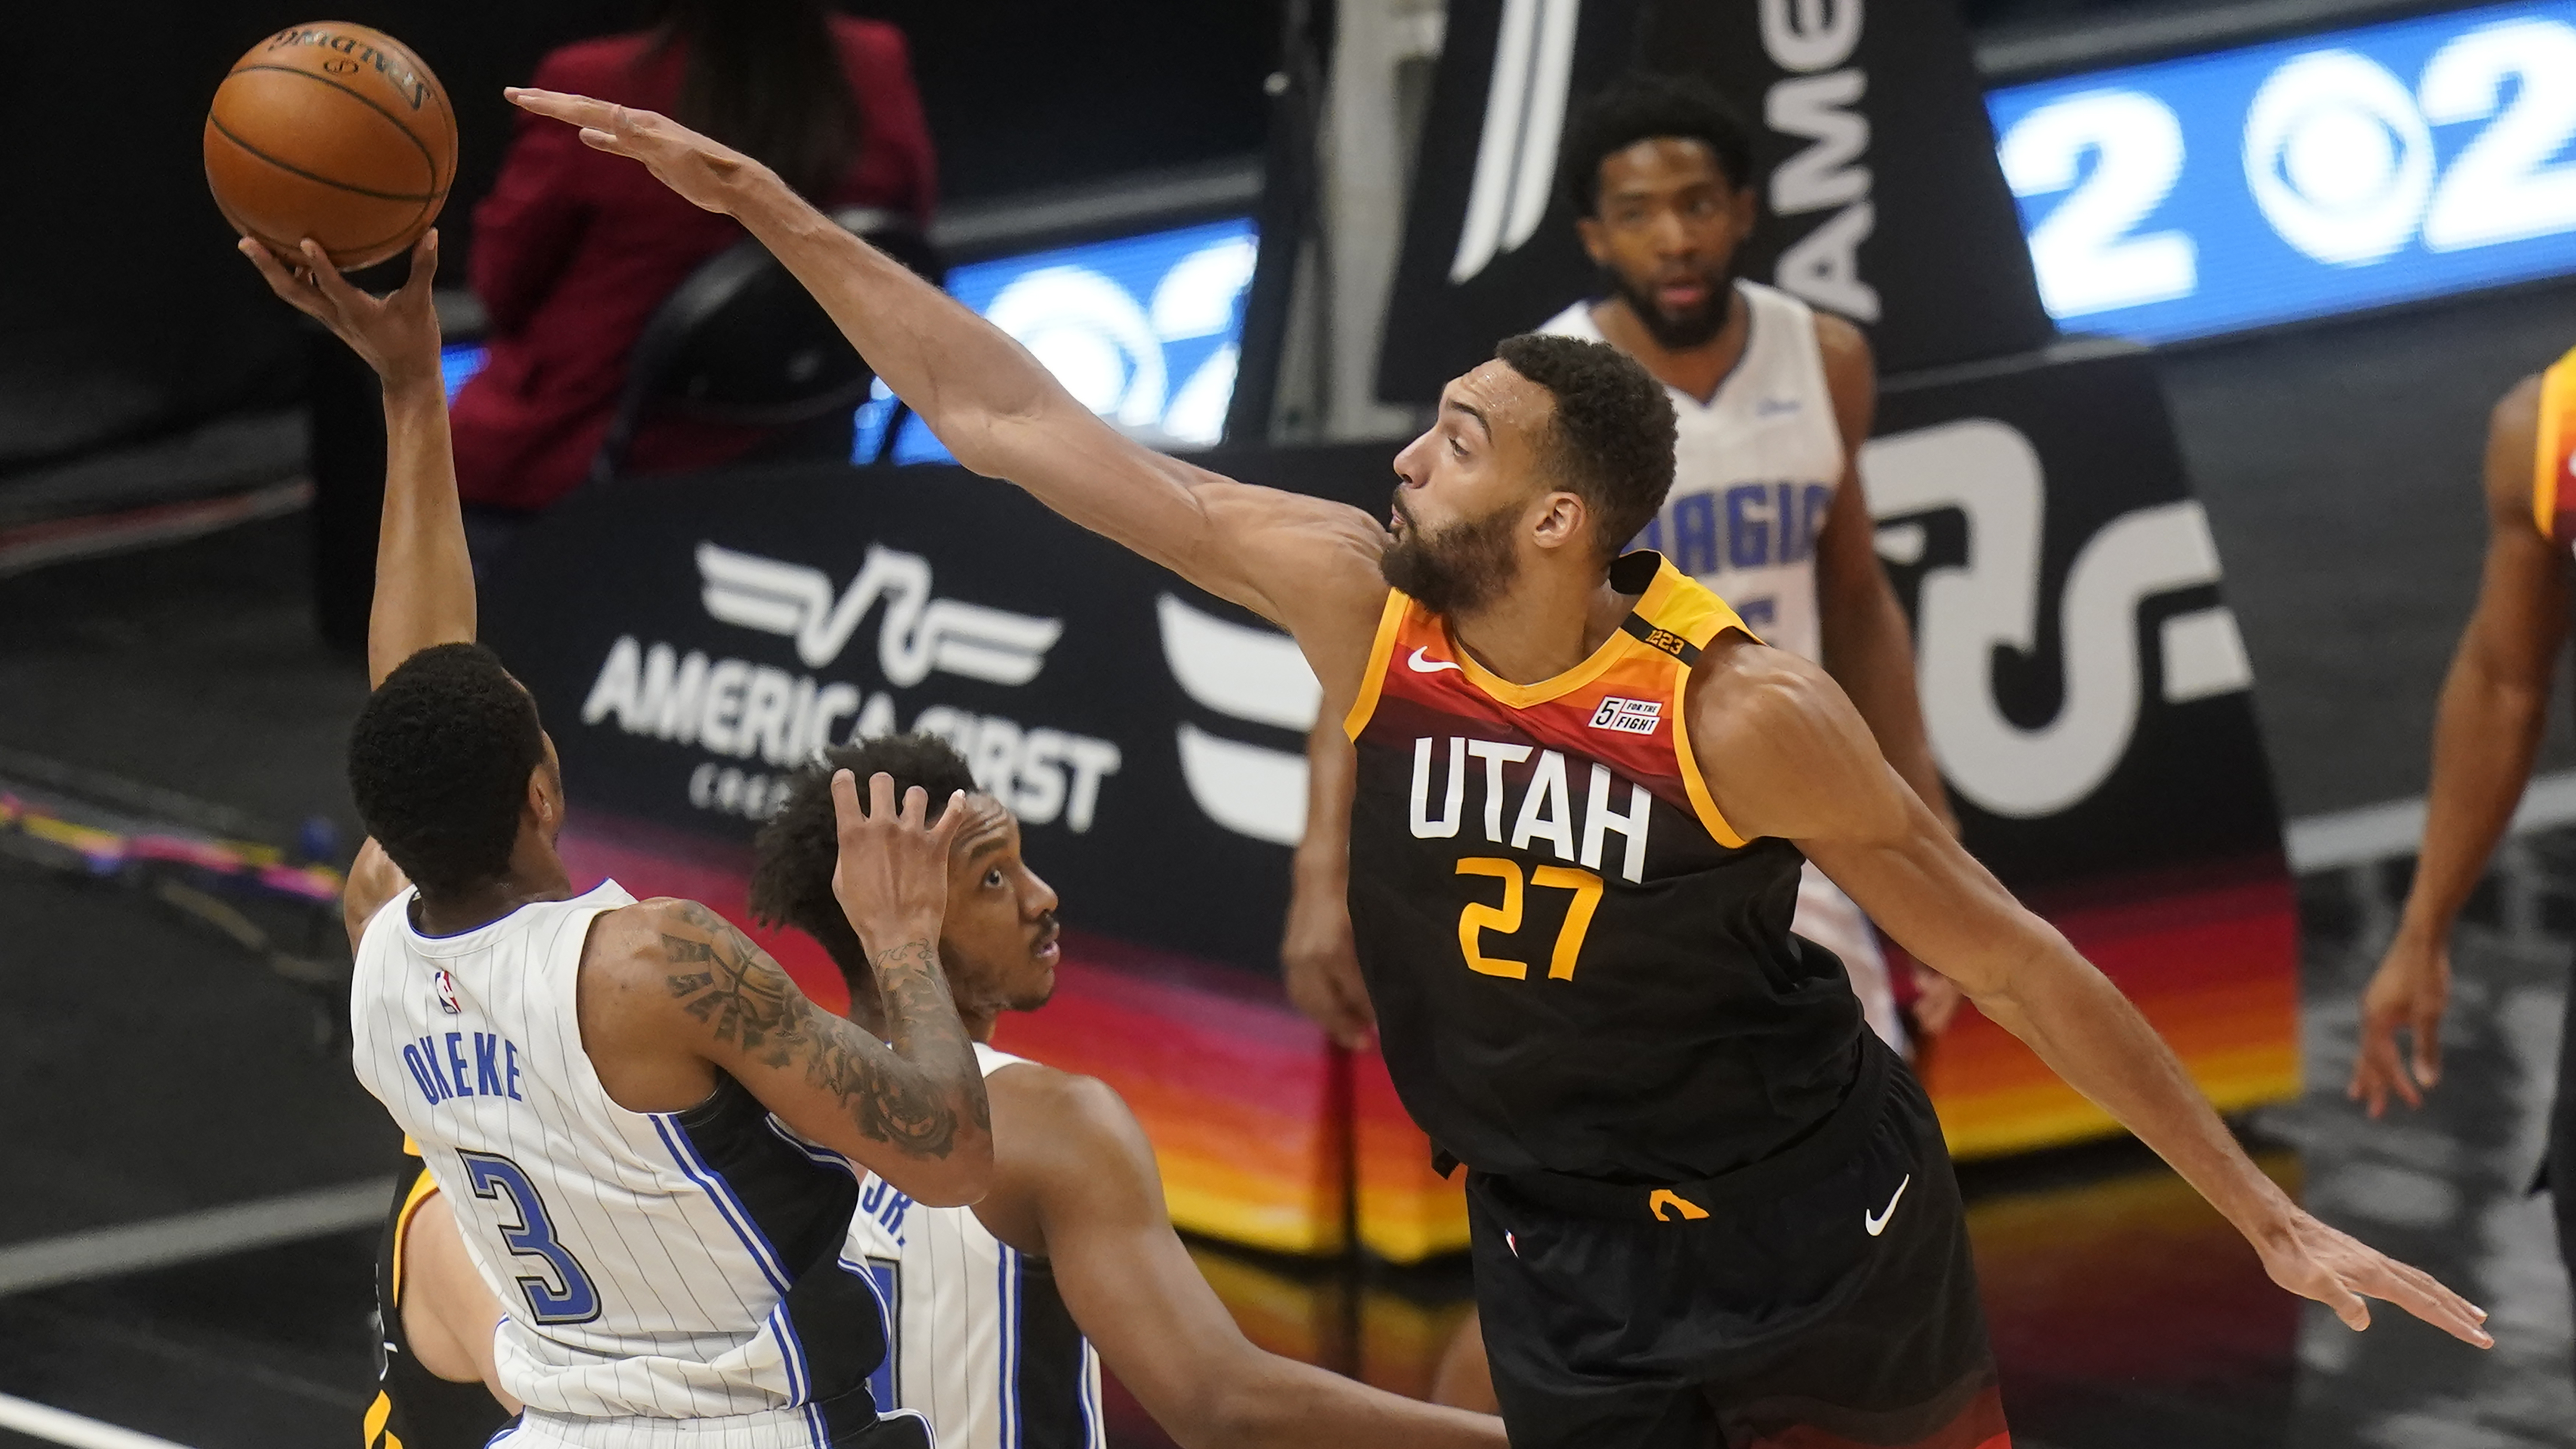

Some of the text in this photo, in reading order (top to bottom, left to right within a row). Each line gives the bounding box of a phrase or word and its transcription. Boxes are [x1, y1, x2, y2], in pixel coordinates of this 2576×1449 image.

[1995, 88, 2199, 320] 2
[1645, 630, 1684, 655] 1223
[1596, 700, 1620, 725] 5
[1616, 716, 1656, 731] FIGHT
[1627, 703, 1658, 713] FOR THE
[1410, 736, 1652, 884] UTAH
[1455, 857, 1604, 982] 27
[403, 1032, 522, 1106] OKEKE
[455, 1147, 602, 1326] 3
